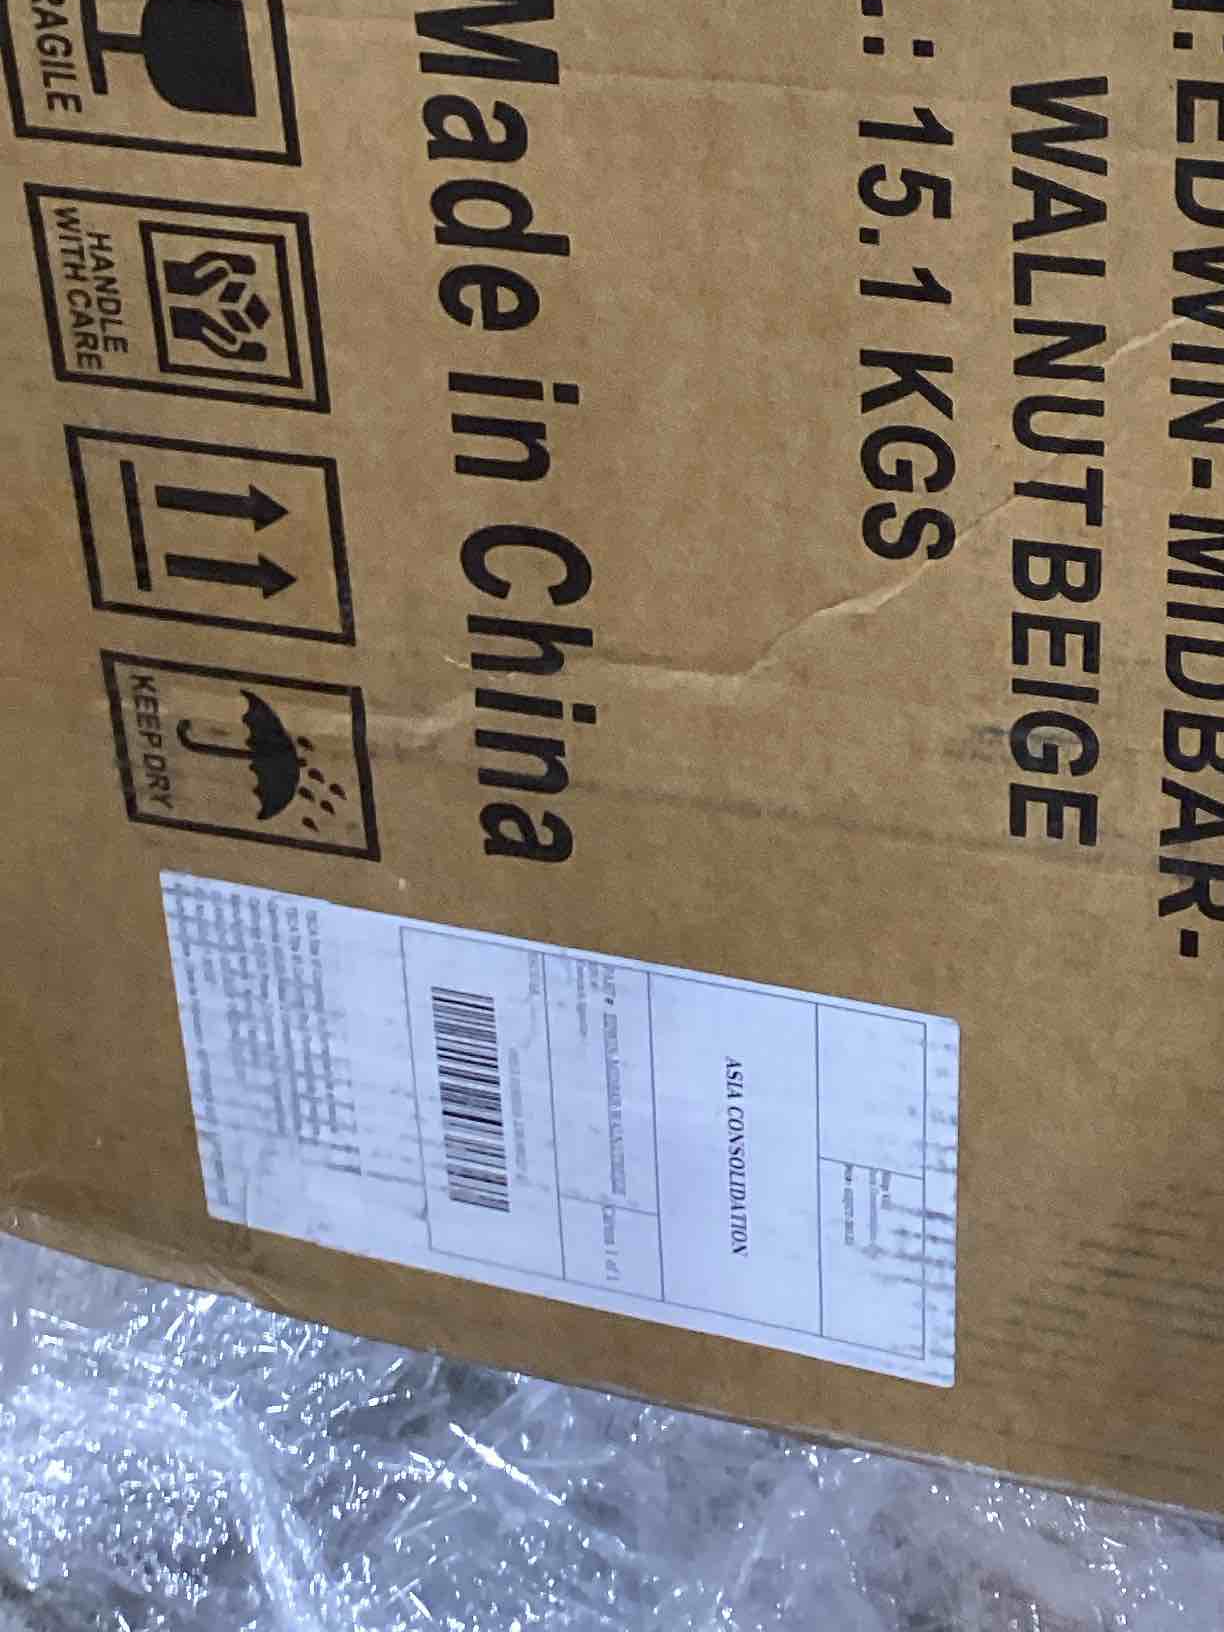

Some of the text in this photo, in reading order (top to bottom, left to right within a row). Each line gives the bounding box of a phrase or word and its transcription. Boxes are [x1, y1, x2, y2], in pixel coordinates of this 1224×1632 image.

[54, 206, 102, 369] WITH CARE
[86, 231, 129, 353] HANDLE
[857, 106, 955, 307] 15.1
[448, 371, 580, 482] in
[859, 348, 957, 560] KGS
[130, 674, 174, 809] KEEP DRY
[459, 524, 597, 864] China
[725, 1055, 749, 1258] ASIA CONSOLIDATION
